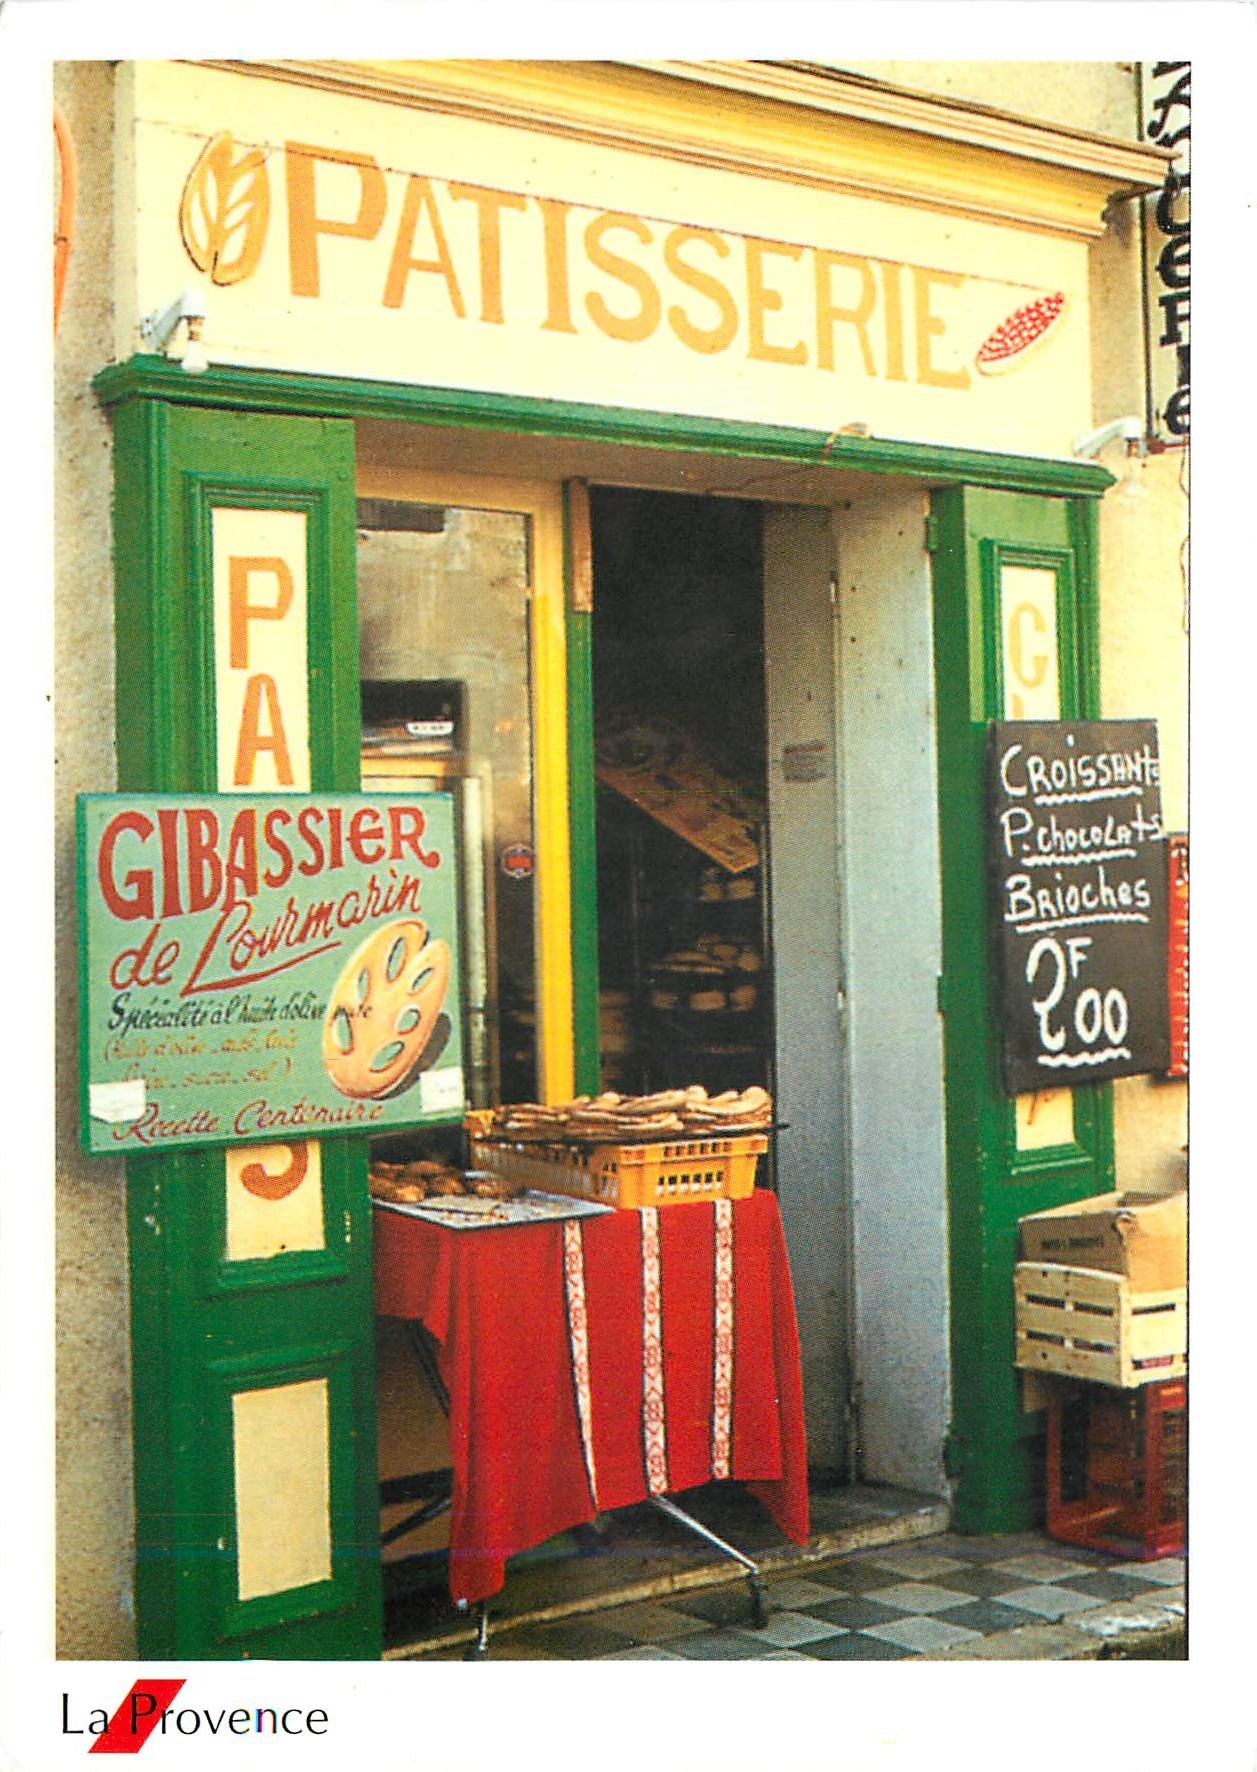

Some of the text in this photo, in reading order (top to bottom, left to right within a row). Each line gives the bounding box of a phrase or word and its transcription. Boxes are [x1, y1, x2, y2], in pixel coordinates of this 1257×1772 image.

[285, 140, 972, 391] PATISSERIE
[98, 806, 441, 921] GIBASSIER
[109, 867, 422, 999] de Lourmarin
